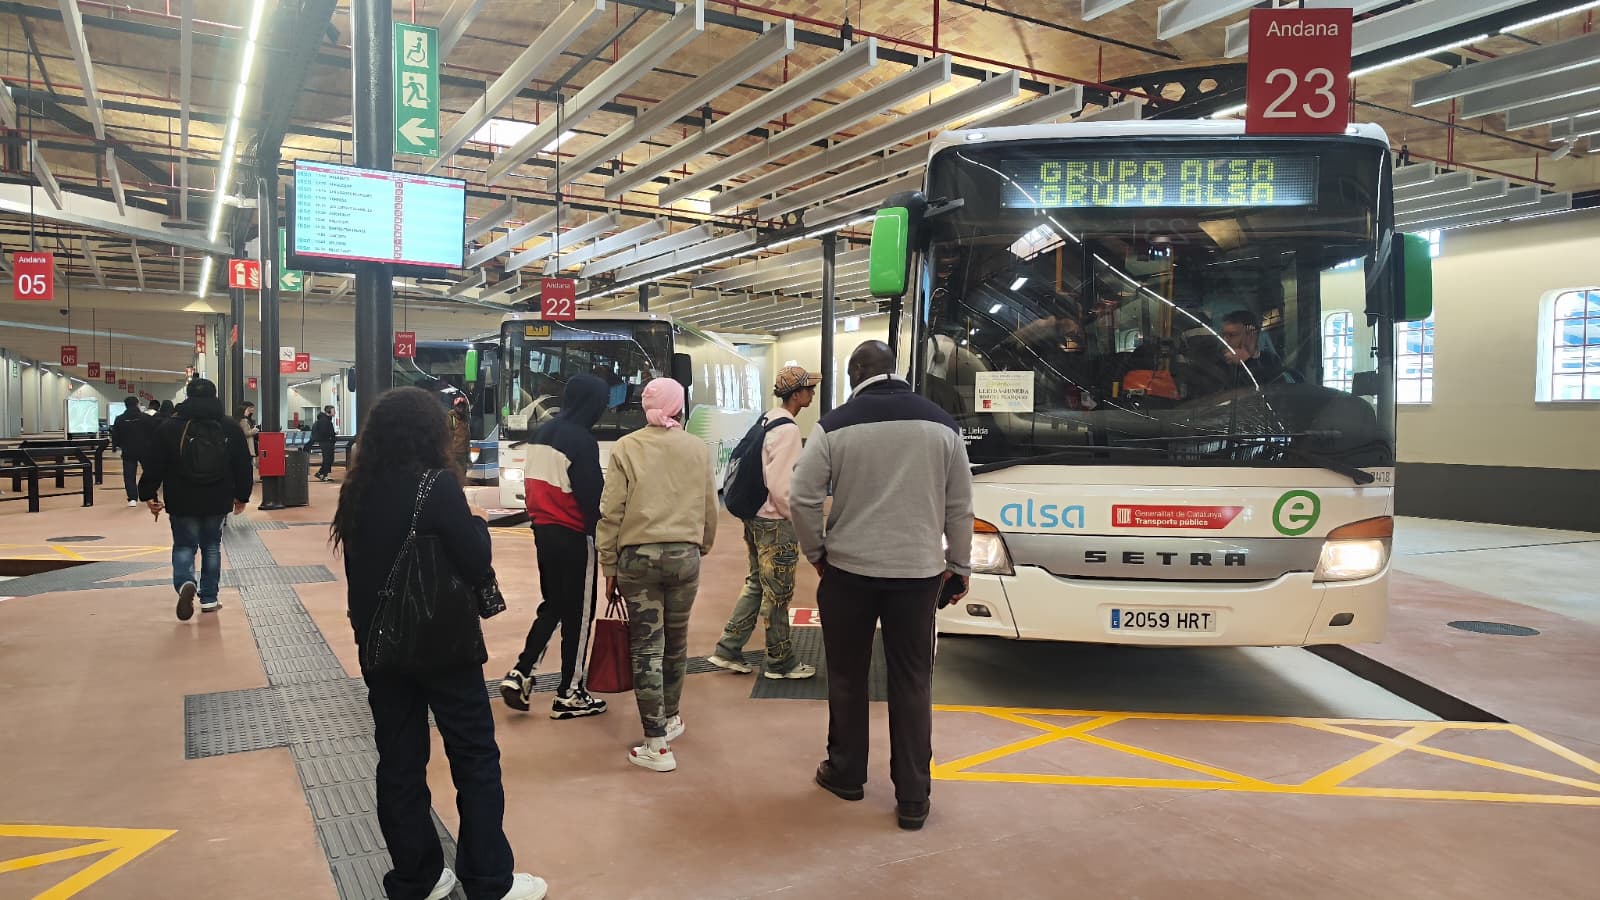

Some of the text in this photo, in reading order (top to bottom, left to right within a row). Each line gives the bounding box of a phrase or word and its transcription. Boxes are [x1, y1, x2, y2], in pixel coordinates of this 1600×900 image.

[1266, 20, 1339, 37] Andana
[1263, 67, 1336, 119] 23
[1040, 159, 1274, 183] GRUPO ALSA
[1040, 182, 1274, 206] GRUPO ALSA
[18, 256, 46, 264] Andana
[18, 274, 46, 295] 05
[546, 298, 571, 316] 22
[398, 343, 412, 354] 21
[62, 354, 75, 364] 06
[296, 361, 308, 371] 20
[1000, 498, 1085, 528] alsa
[1135, 509, 1223, 520] Generalitat de Catalunya
[1135, 518, 1209, 527] Transports públics
[1084, 550, 1247, 567] SETRA
[1124, 611, 1170, 629] 2059
[1177, 612, 1211, 630] HRT
